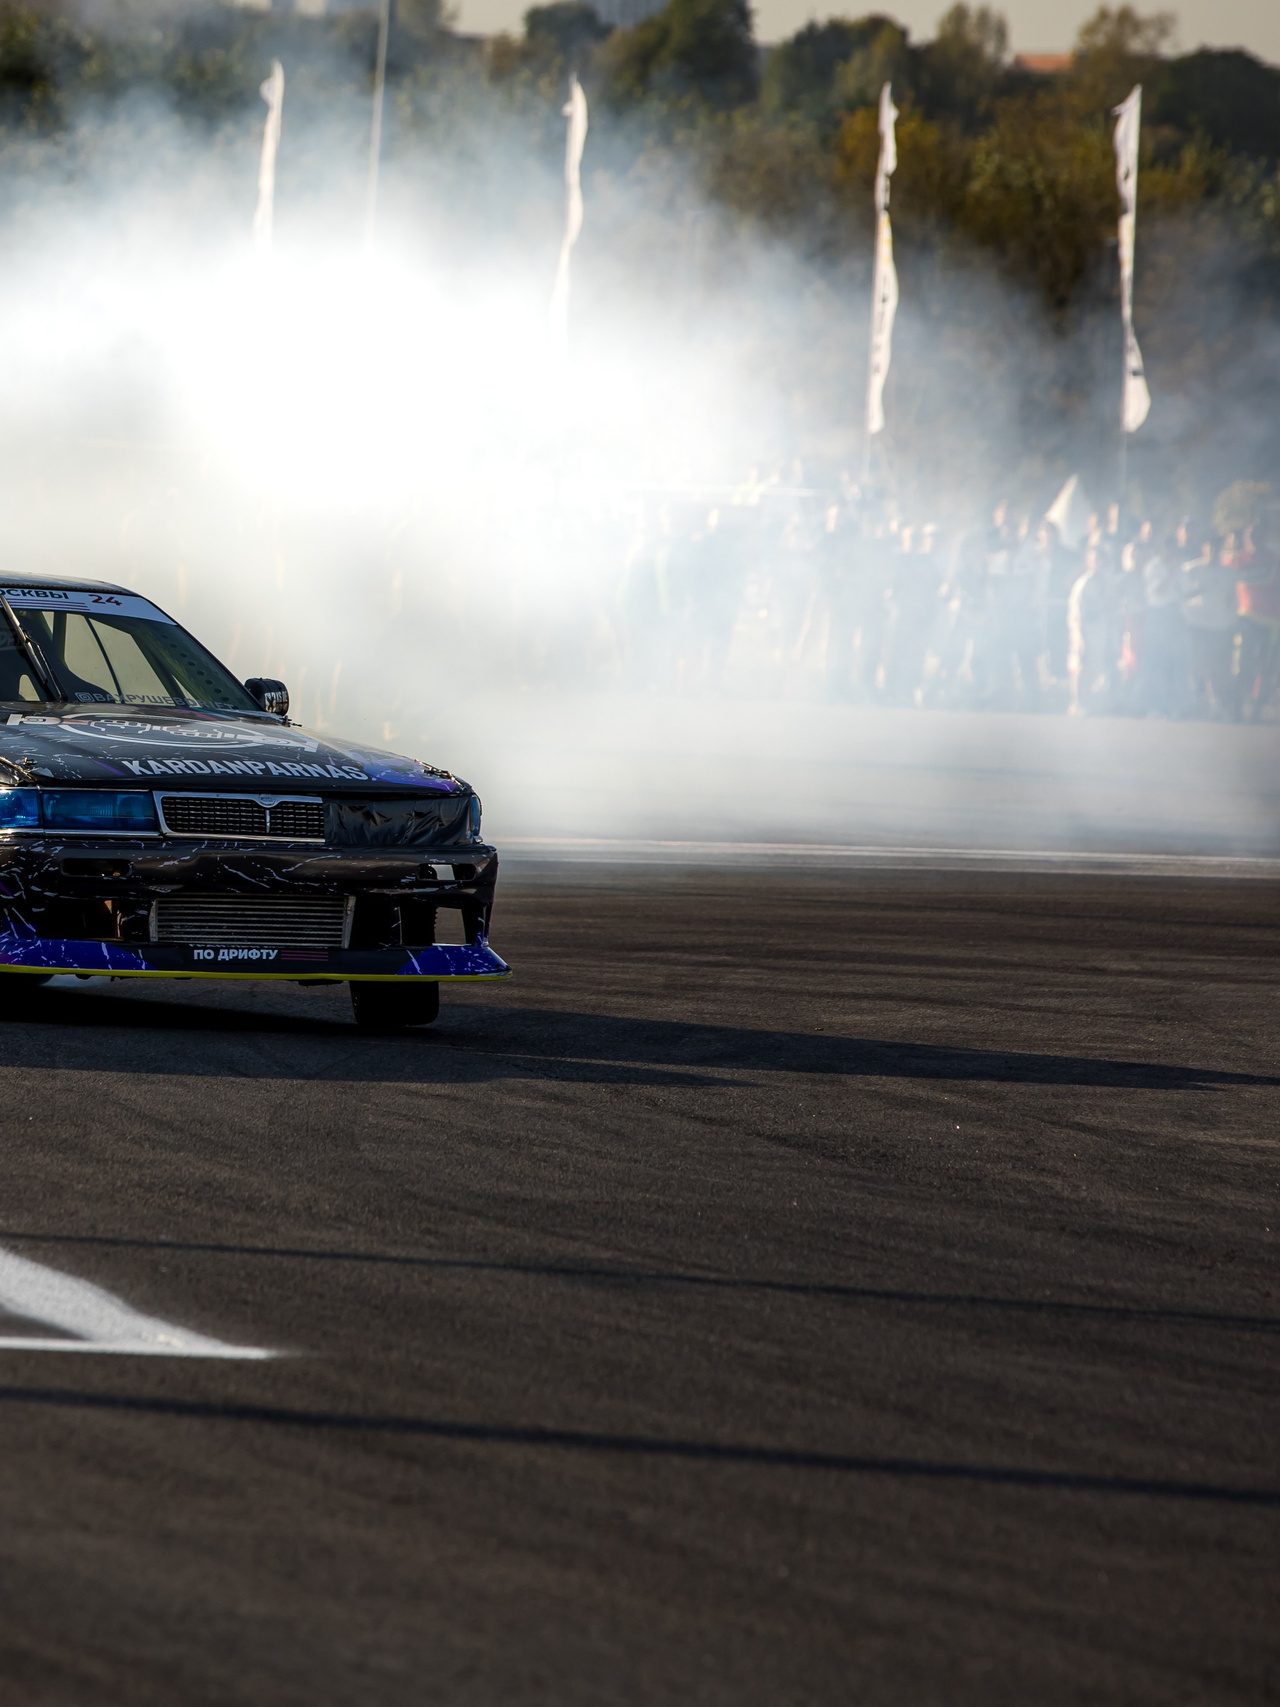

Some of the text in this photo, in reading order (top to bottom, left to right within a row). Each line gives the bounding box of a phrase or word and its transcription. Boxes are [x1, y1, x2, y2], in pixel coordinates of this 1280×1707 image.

[88, 594, 122, 606] 24
[121, 759, 369, 781] KARDANPARNAS
[193, 949, 278, 961] ПО ДРИФТУ
